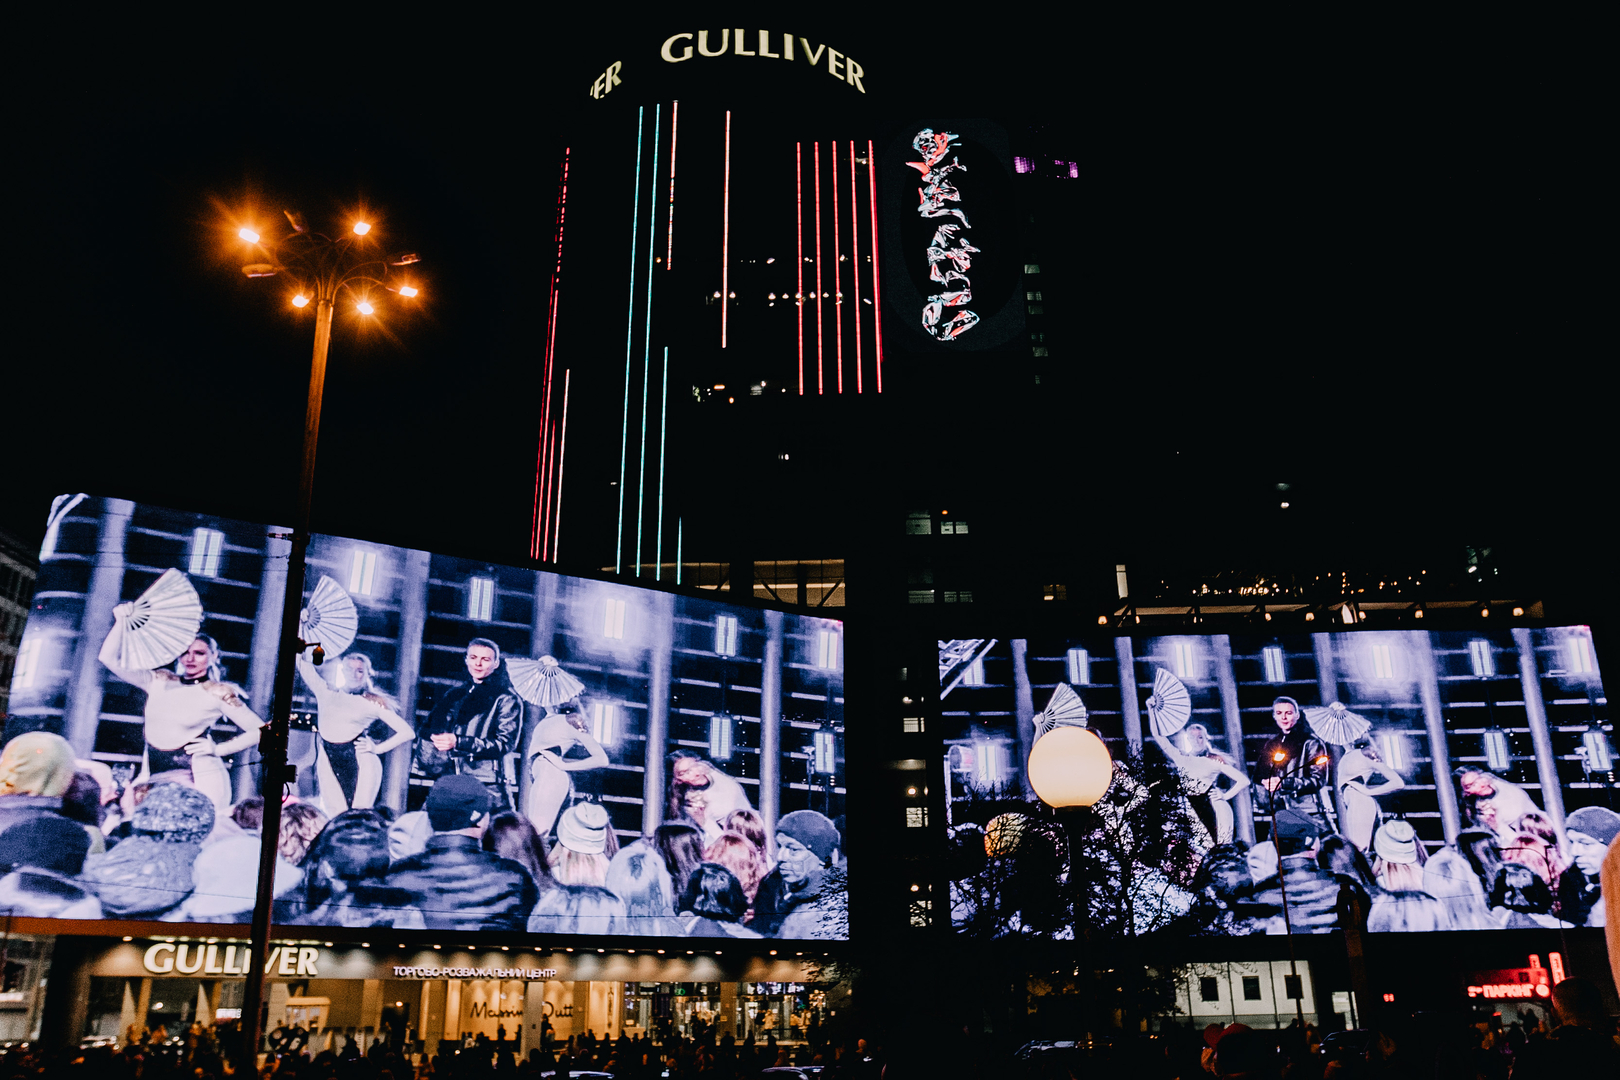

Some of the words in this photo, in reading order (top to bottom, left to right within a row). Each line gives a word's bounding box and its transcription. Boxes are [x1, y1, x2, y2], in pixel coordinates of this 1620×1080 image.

[661, 28, 866, 94] GULLIVER
[589, 60, 623, 100] ER
[526, 968, 558, 980] ЦЕНТР
[1482, 983, 1535, 998] ПАРКІНГ
[469, 1001, 524, 1019] Massim
